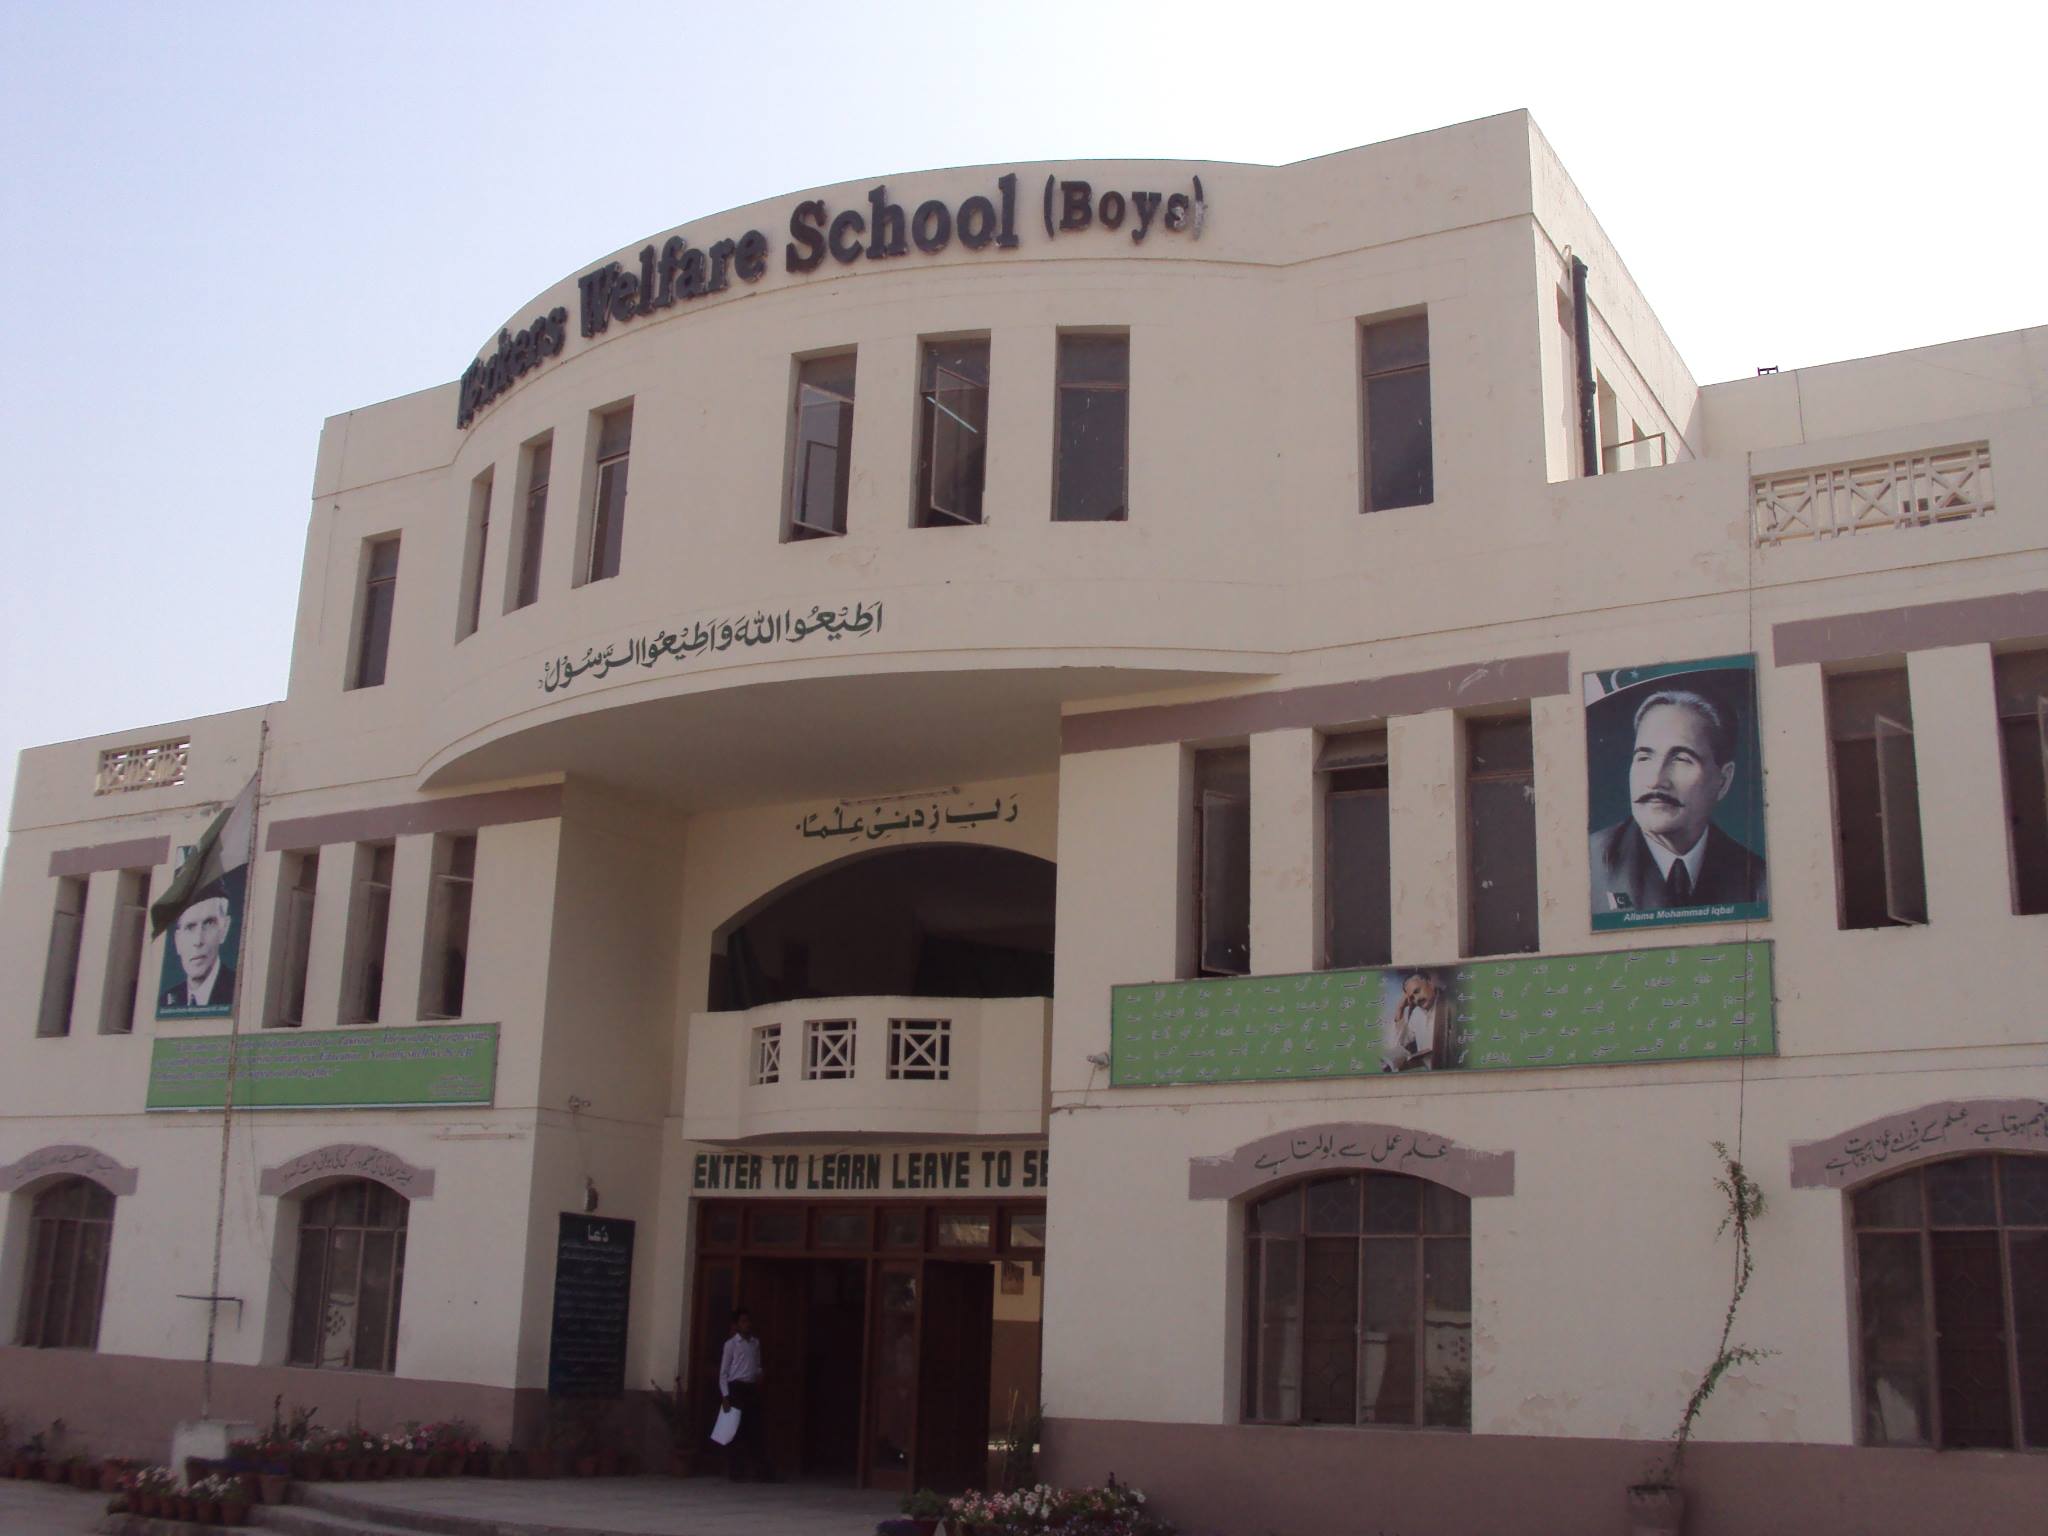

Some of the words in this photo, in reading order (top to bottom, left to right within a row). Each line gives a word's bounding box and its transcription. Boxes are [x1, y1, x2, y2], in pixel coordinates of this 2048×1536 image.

[577, 229, 768, 339] Welfare
[785, 171, 1020, 275] School
[1656, 906, 1710, 919] Mohammad
[1711, 905, 1735, 917] Iqbal
[694, 1154, 762, 1190] ENTER
[772, 1154, 799, 1190] TO
[807, 1153, 880, 1190] LEARN
[892, 1151, 970, 1189] LEAVE
[981, 1150, 1011, 1188] TO
